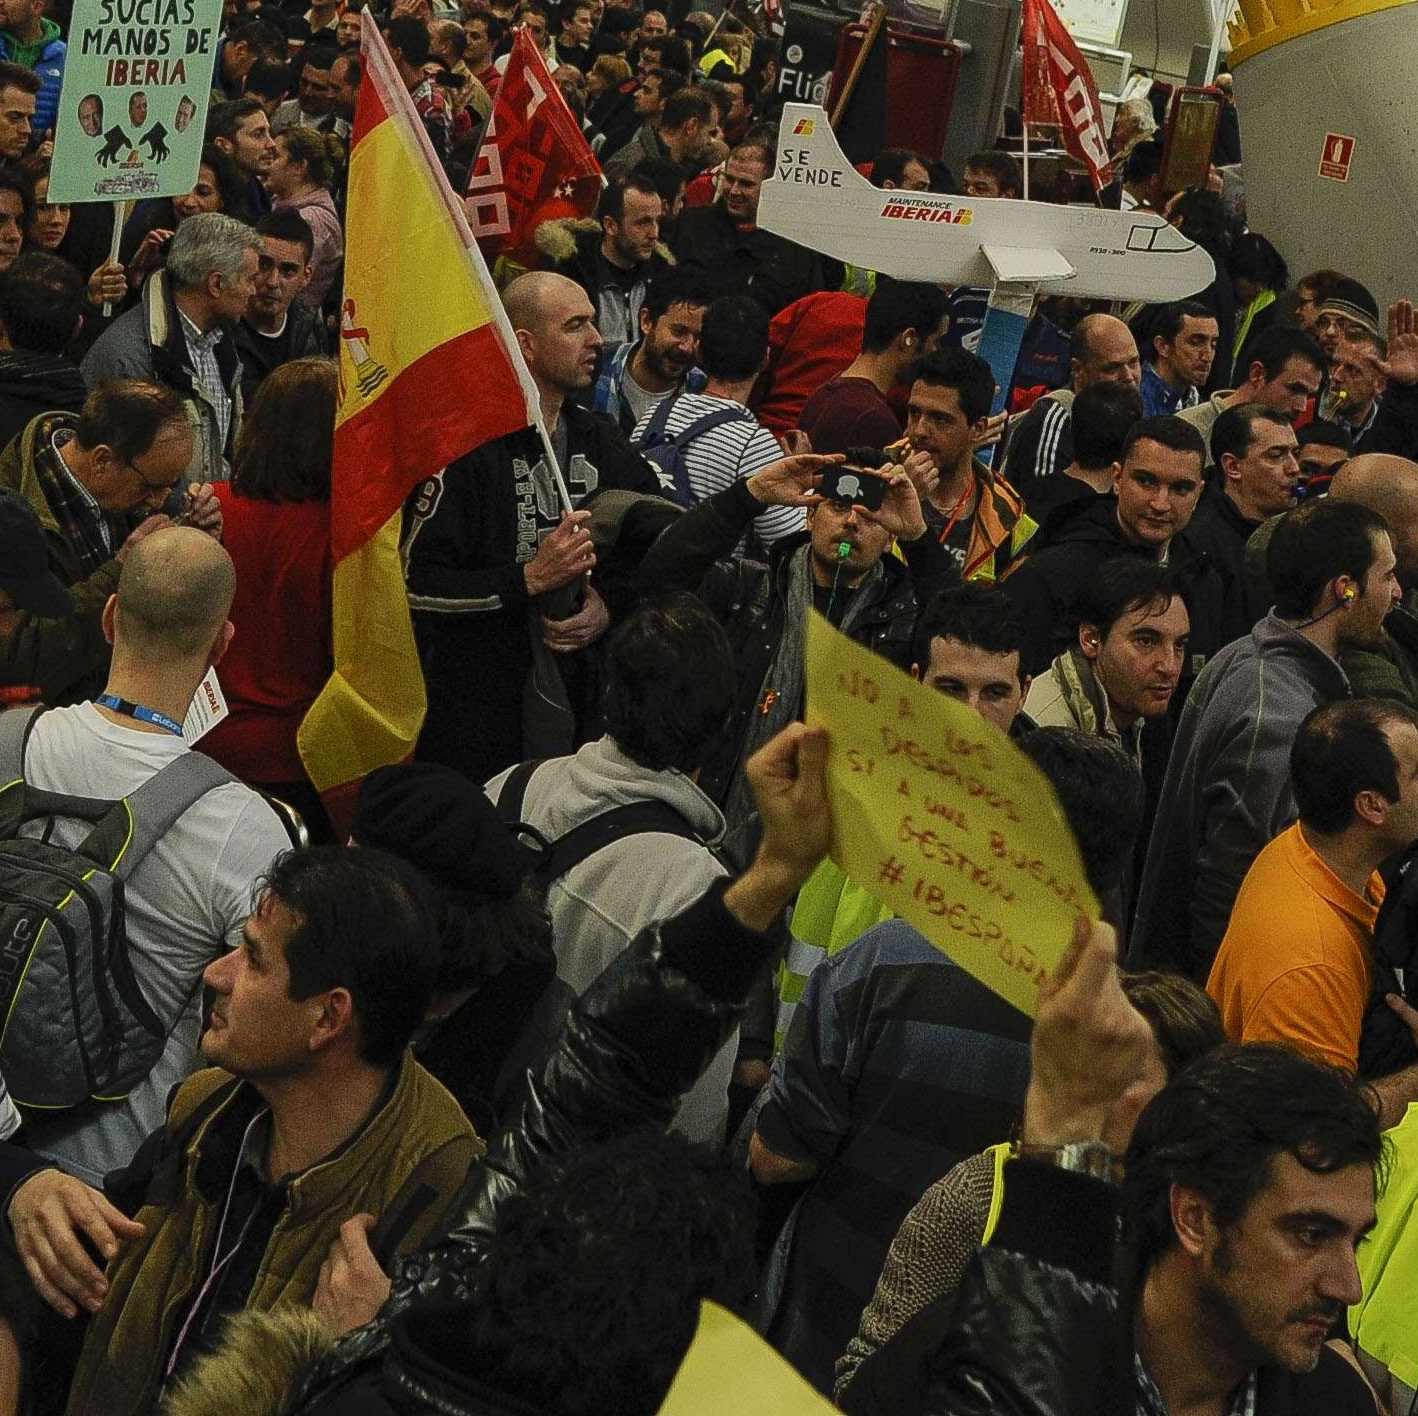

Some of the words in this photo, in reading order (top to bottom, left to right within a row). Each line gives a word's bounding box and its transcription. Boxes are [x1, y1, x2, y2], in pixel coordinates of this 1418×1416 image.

[81, 27, 172, 56] MANOS
[185, 27, 212, 55] DE
[106, 58, 187, 87] IBERIA
[782, 149, 811, 166] SE
[779, 166, 844, 188] VENDE
[881, 204, 955, 224] IBERIA
[887, 197, 953, 210] MAINTENANCE
